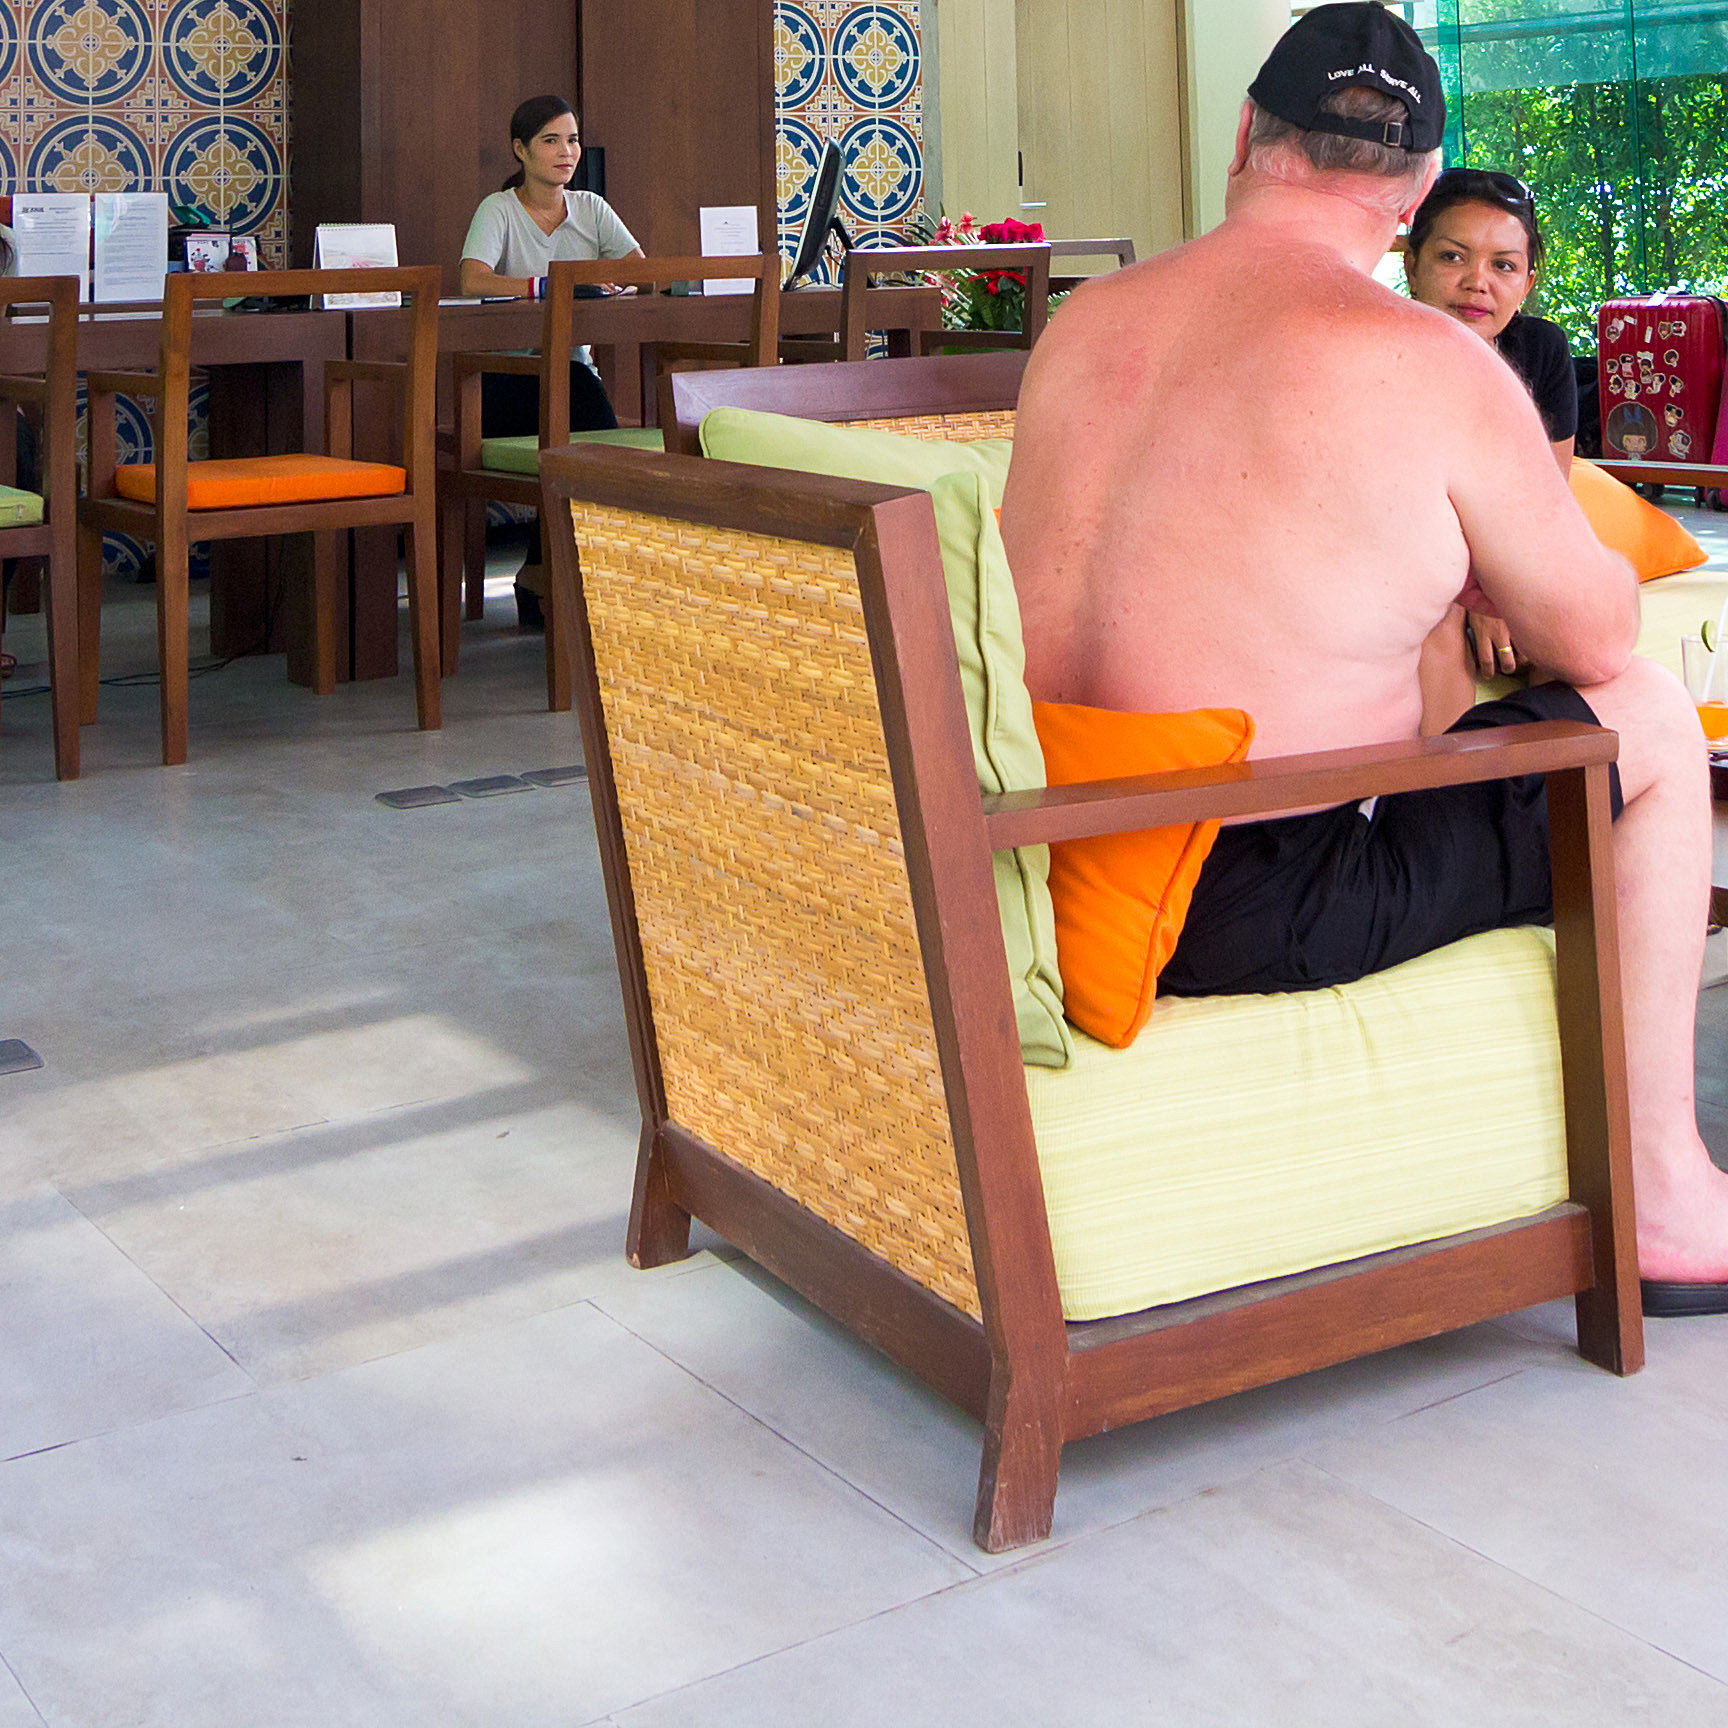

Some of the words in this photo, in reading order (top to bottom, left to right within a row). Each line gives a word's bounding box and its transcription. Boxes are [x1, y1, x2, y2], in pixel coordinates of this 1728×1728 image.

[1327, 68, 1355, 81] LOVE
[1357, 63, 1376, 75] ALL
[1379, 68, 1409, 90] SERVE
[1407, 85, 1422, 104] ALL
